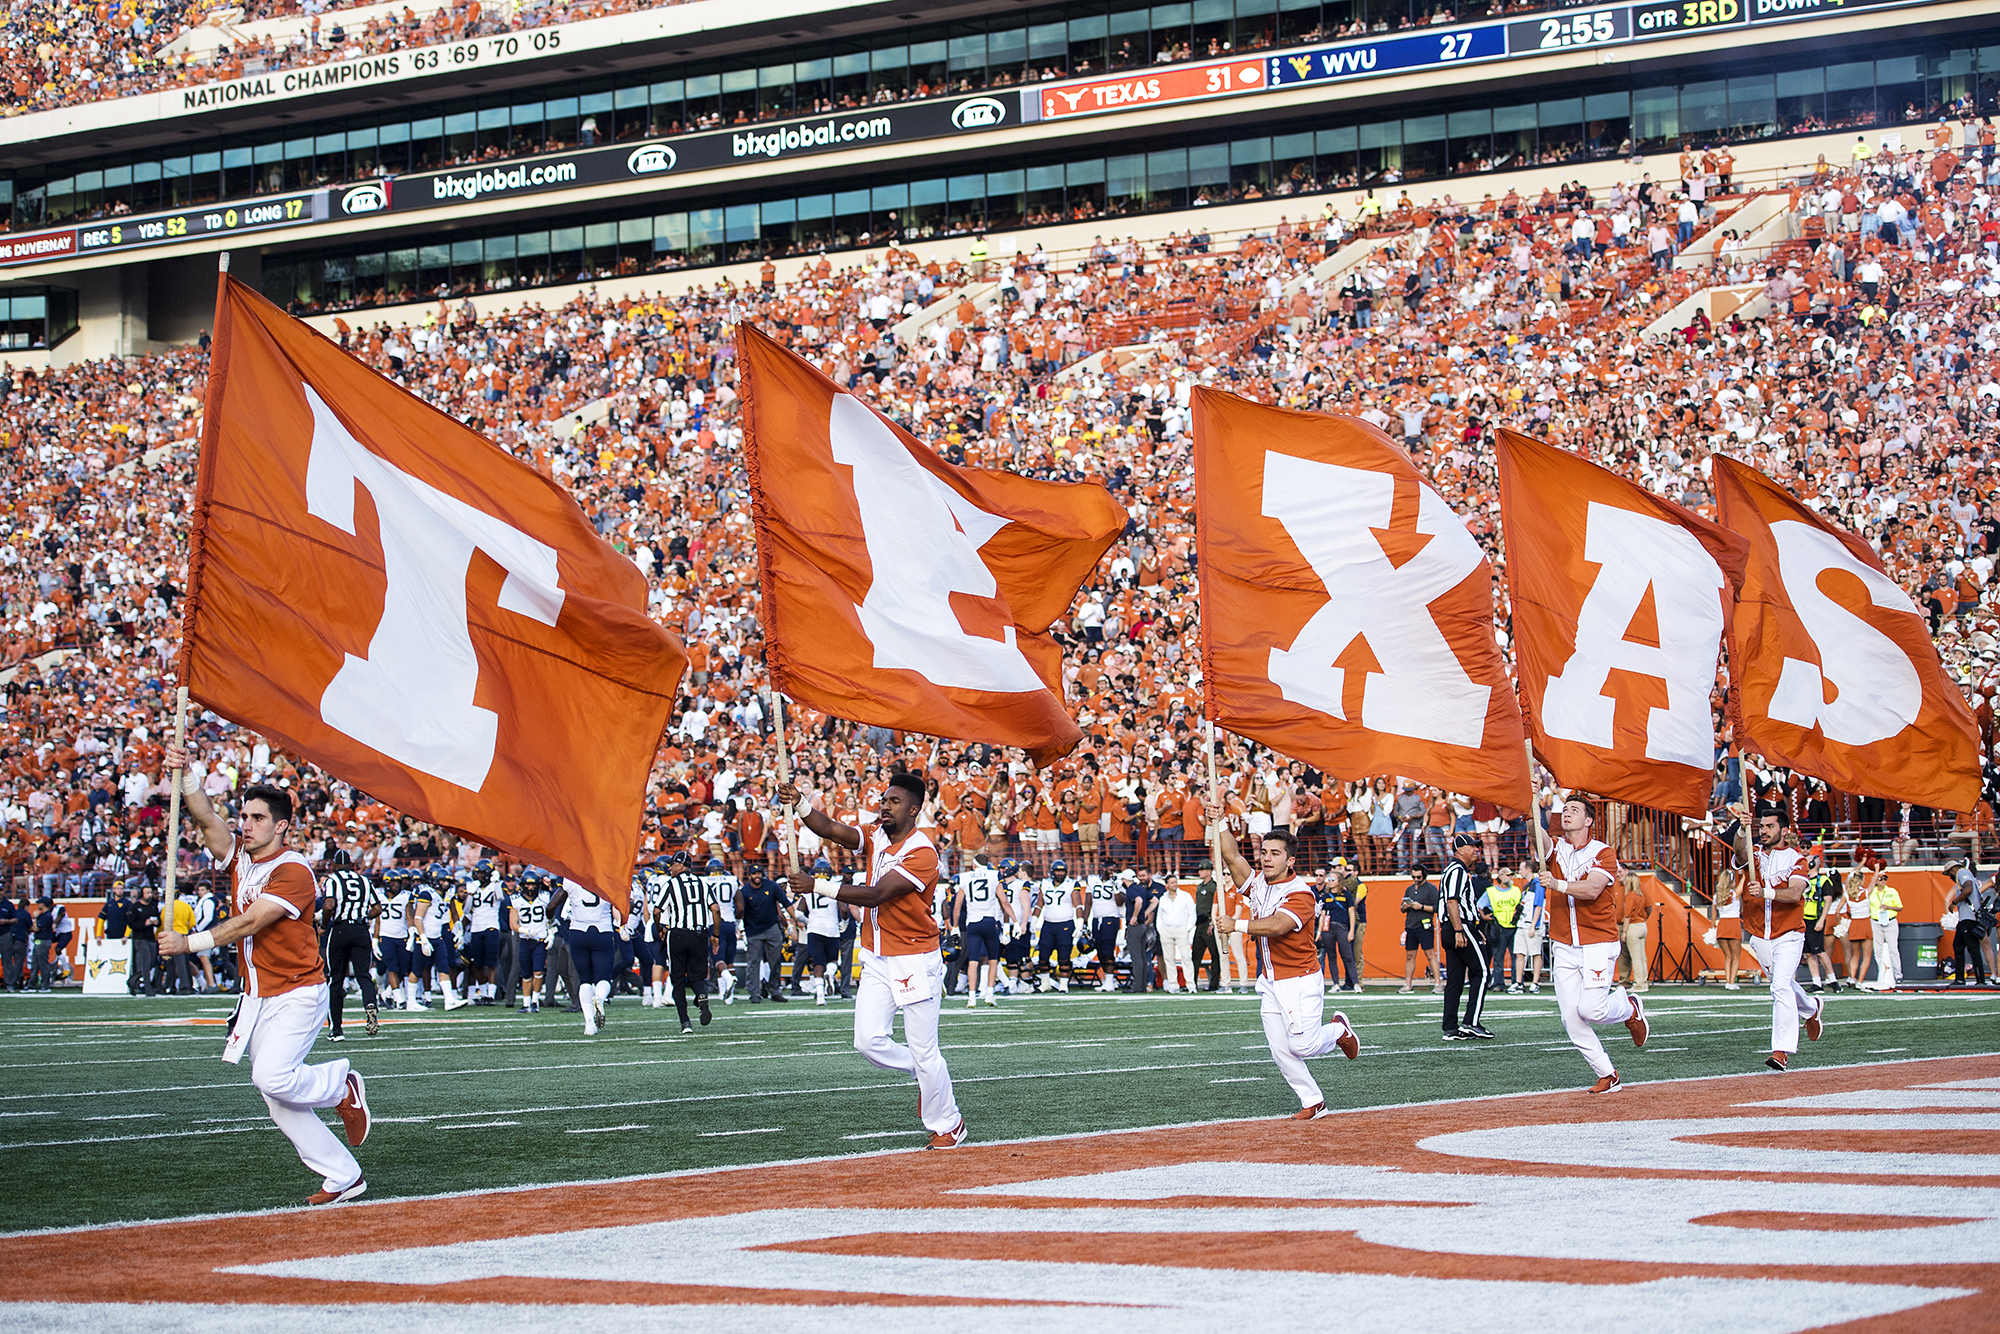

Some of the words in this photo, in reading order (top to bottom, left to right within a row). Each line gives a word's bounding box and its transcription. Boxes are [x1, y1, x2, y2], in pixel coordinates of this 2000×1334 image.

[1540, 12, 1614, 48] 2:55
[1638, 9, 1678, 30] QTR
[1683, 0, 1738, 27] 3RD
[184, 78, 276, 109] NATIONAL
[284, 57, 400, 92] CHAMPIONS
[408, 50, 439, 70] '63
[488, 37, 519, 58] '70
[528, 30, 561, 51] '05
[1321, 48, 1377, 75] WVU
[1440, 33, 1473, 60] 27
[1093, 79, 1161, 107] TEXAS
[1205, 67, 1232, 92] 31
[732, 117, 891, 157] btxglobal.com
[433, 162, 576, 199] btxglobal.com
[83, 230, 109, 247] REC
[111, 226, 122, 244] 5
[138, 222, 164, 239] YDS
[166, 217, 187, 236] 52
[203, 214, 222, 230] TD
[225, 209, 238, 228] 0
[244, 204, 283, 225] LONG
[285, 199, 303, 219] 17
[14, 236, 72, 257] DUVERNAY
[303, 382, 566, 793] T
[1261, 449, 1492, 749] X
[1541, 501, 1726, 771] A
[1767, 520, 1923, 747] S
[345, 879, 361, 901] S
[968, 878, 989, 902] 13
[1044, 889, 1066, 906] 57
[520, 905, 545, 924] 39
[899, 986, 916, 994] TEXAS
